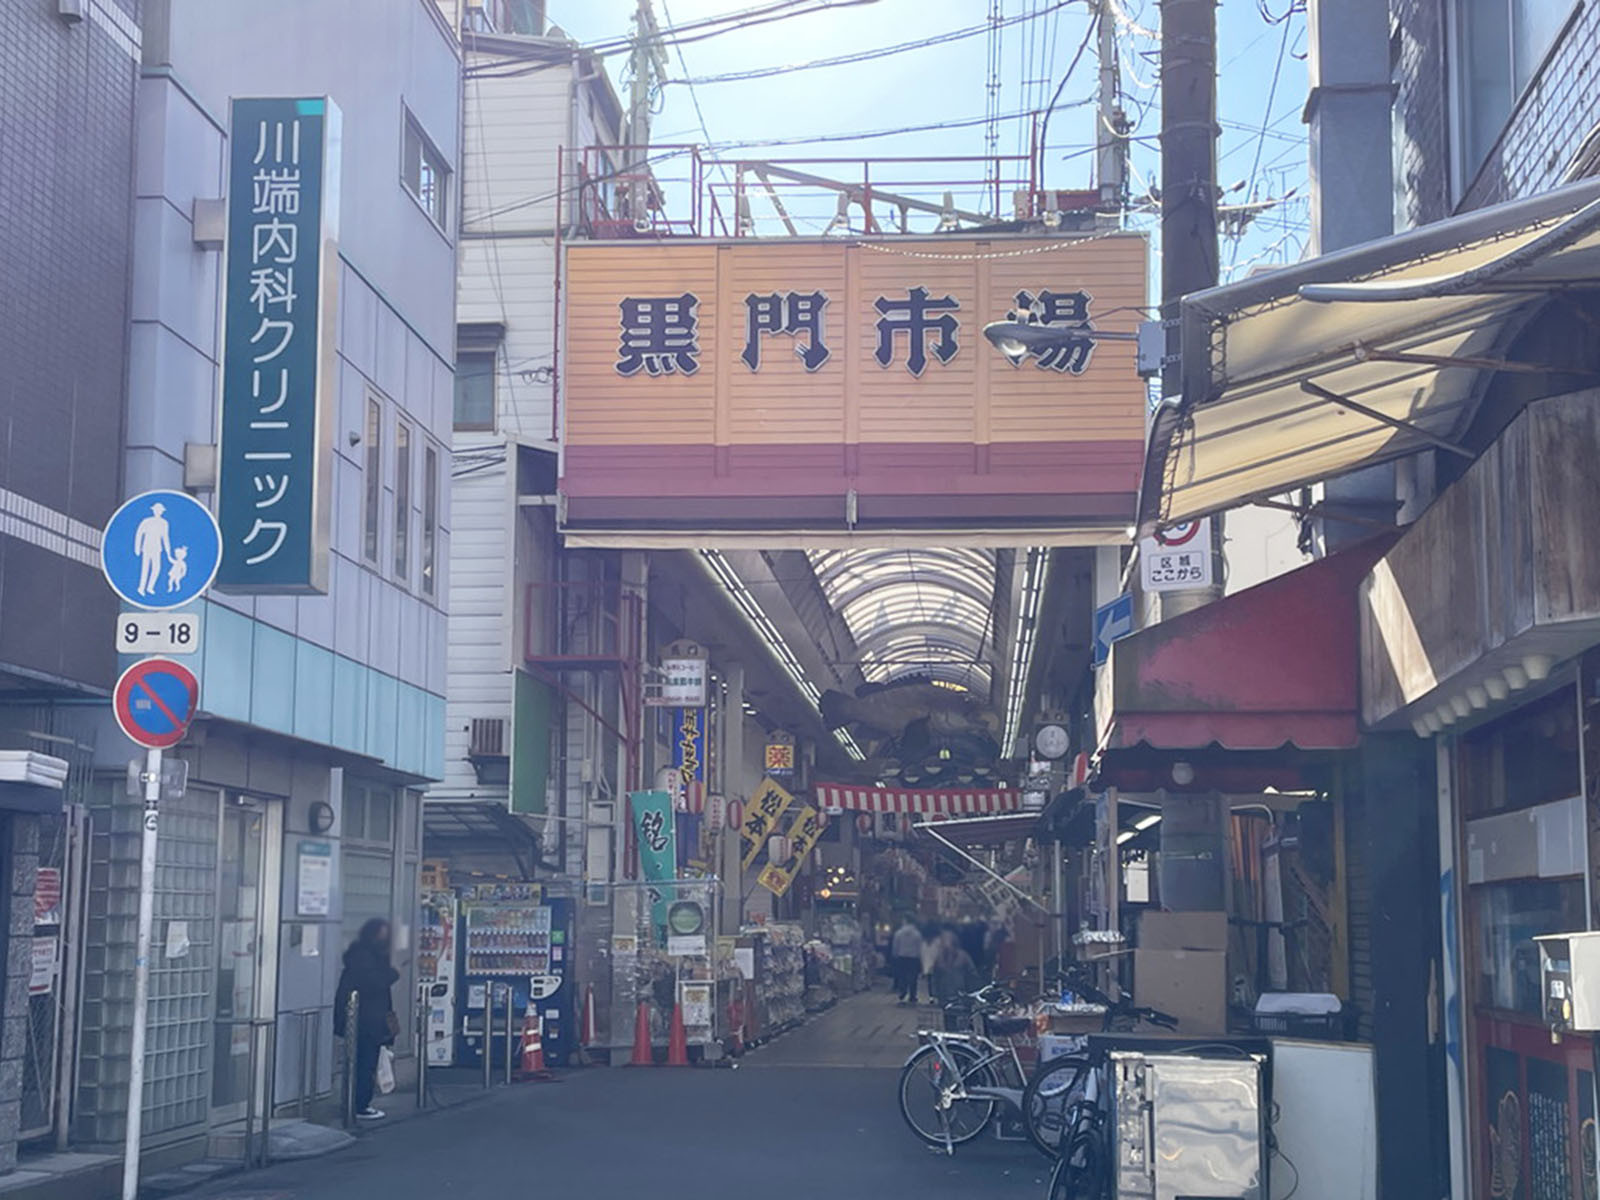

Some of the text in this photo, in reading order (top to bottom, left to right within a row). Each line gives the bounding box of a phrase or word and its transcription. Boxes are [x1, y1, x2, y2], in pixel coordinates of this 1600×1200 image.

[242, 120, 301, 566] 川端内科クリニック
[614, 286, 1098, 377] 黒門市場
[1151, 566, 1202, 582] ここから
